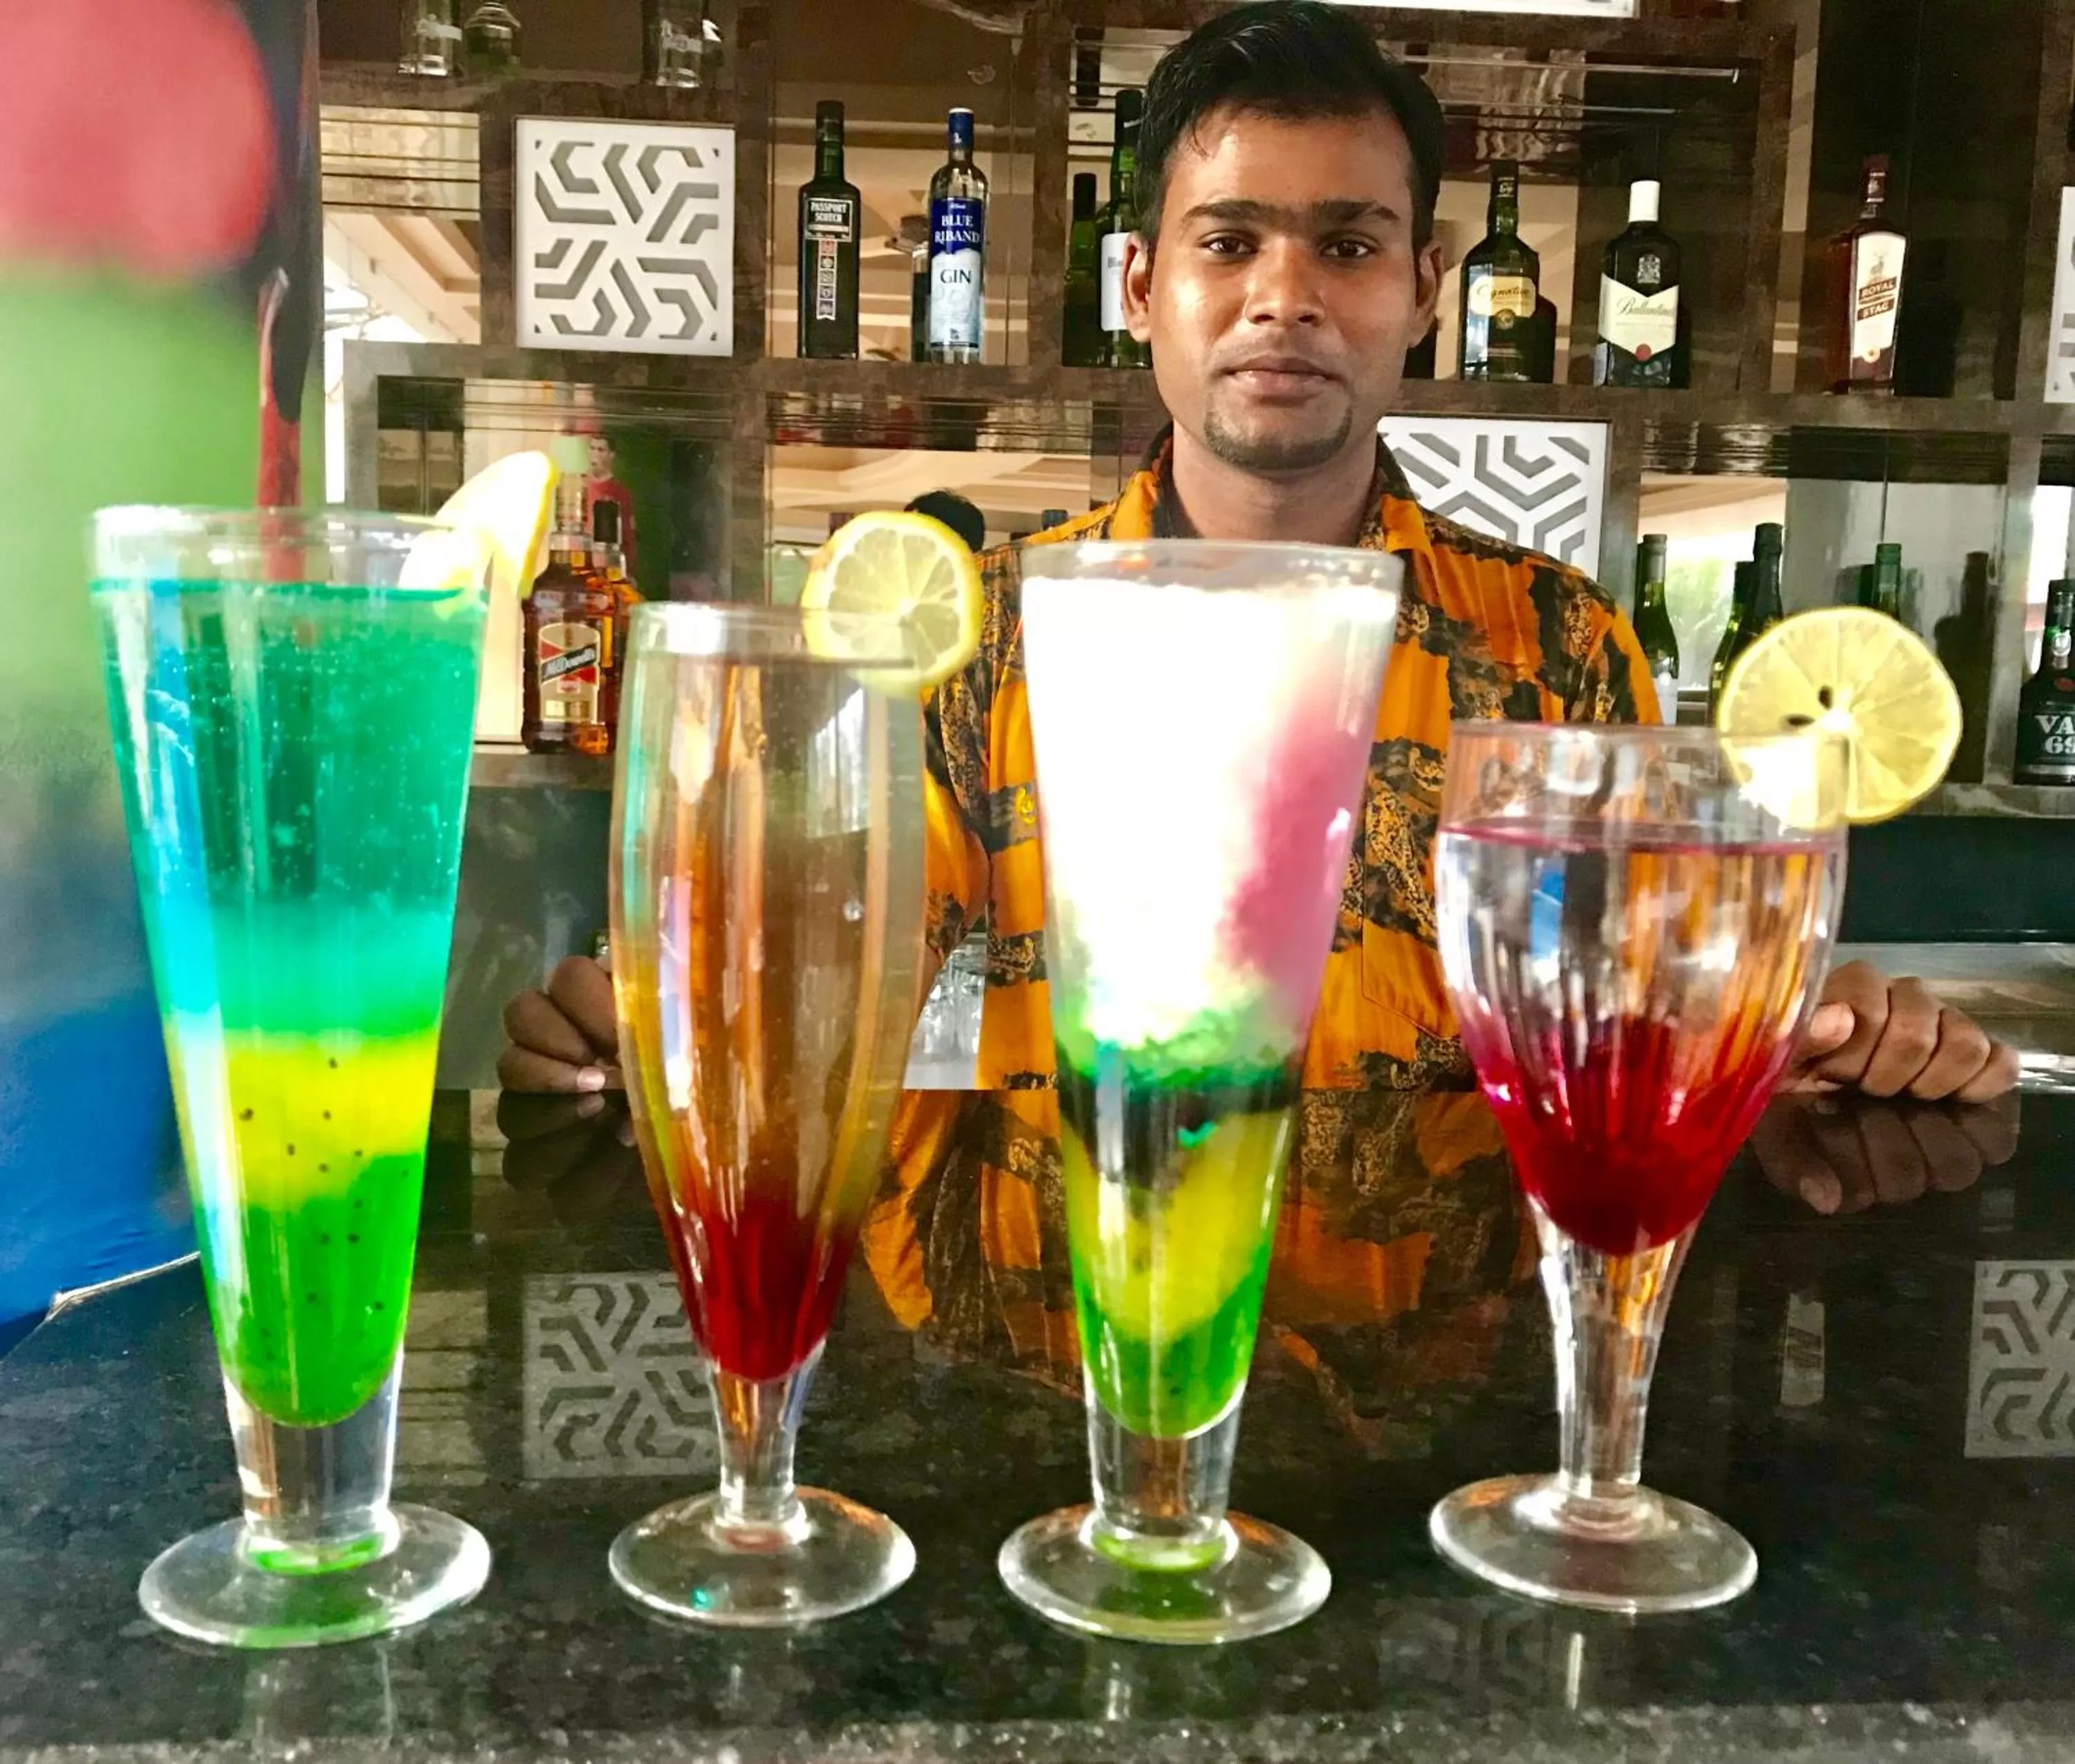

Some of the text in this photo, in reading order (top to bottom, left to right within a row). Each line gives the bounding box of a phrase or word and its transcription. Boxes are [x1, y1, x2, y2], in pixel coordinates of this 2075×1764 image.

[941, 214, 974, 227] BLUE
[934, 230, 980, 244] RIBAND
[940, 269, 972, 284] GIN
[1861, 278, 1894, 297] ROYAL
[1862, 301, 1889, 318] STAG
[2034, 715, 2075, 735] VA
[2045, 735, 2075, 755] 69
